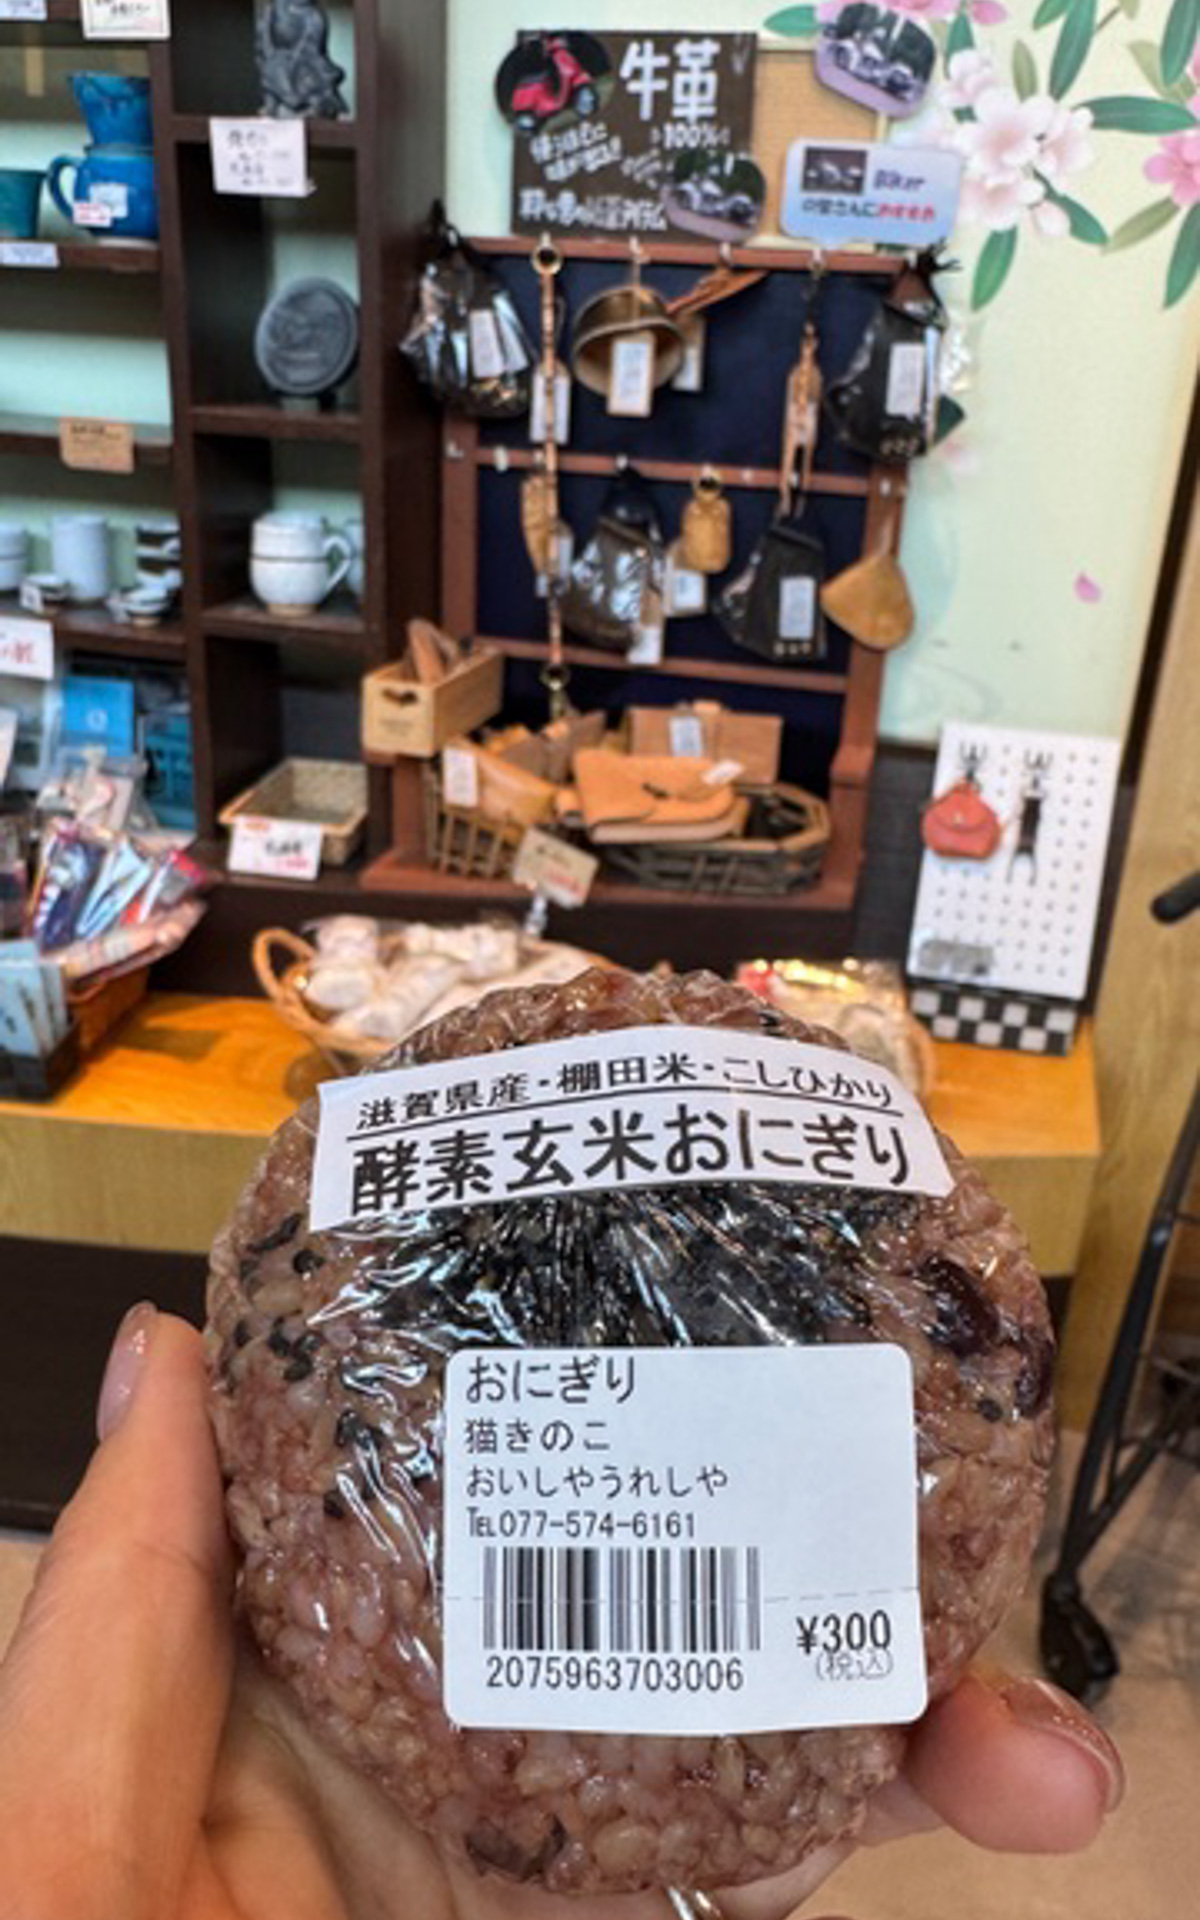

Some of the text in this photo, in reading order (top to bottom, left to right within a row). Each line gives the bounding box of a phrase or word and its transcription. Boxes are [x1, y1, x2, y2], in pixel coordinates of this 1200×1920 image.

[619, 39, 721, 123] 牛革
[356, 1051, 893, 1131] 滋賀県産・棚田米・こしひかり
[350, 1103, 911, 1216] 酵素玄米おにぎり
[465, 1354, 636, 1404] おにぎり
[465, 1418, 610, 1454] 猫きのこ
[466, 1464, 729, 1498] おいしやうれしや
[796, 1609, 892, 1654] ¥300
[486, 1655, 744, 1692] 2075963703006
[816, 1648, 894, 1681] (税込)
